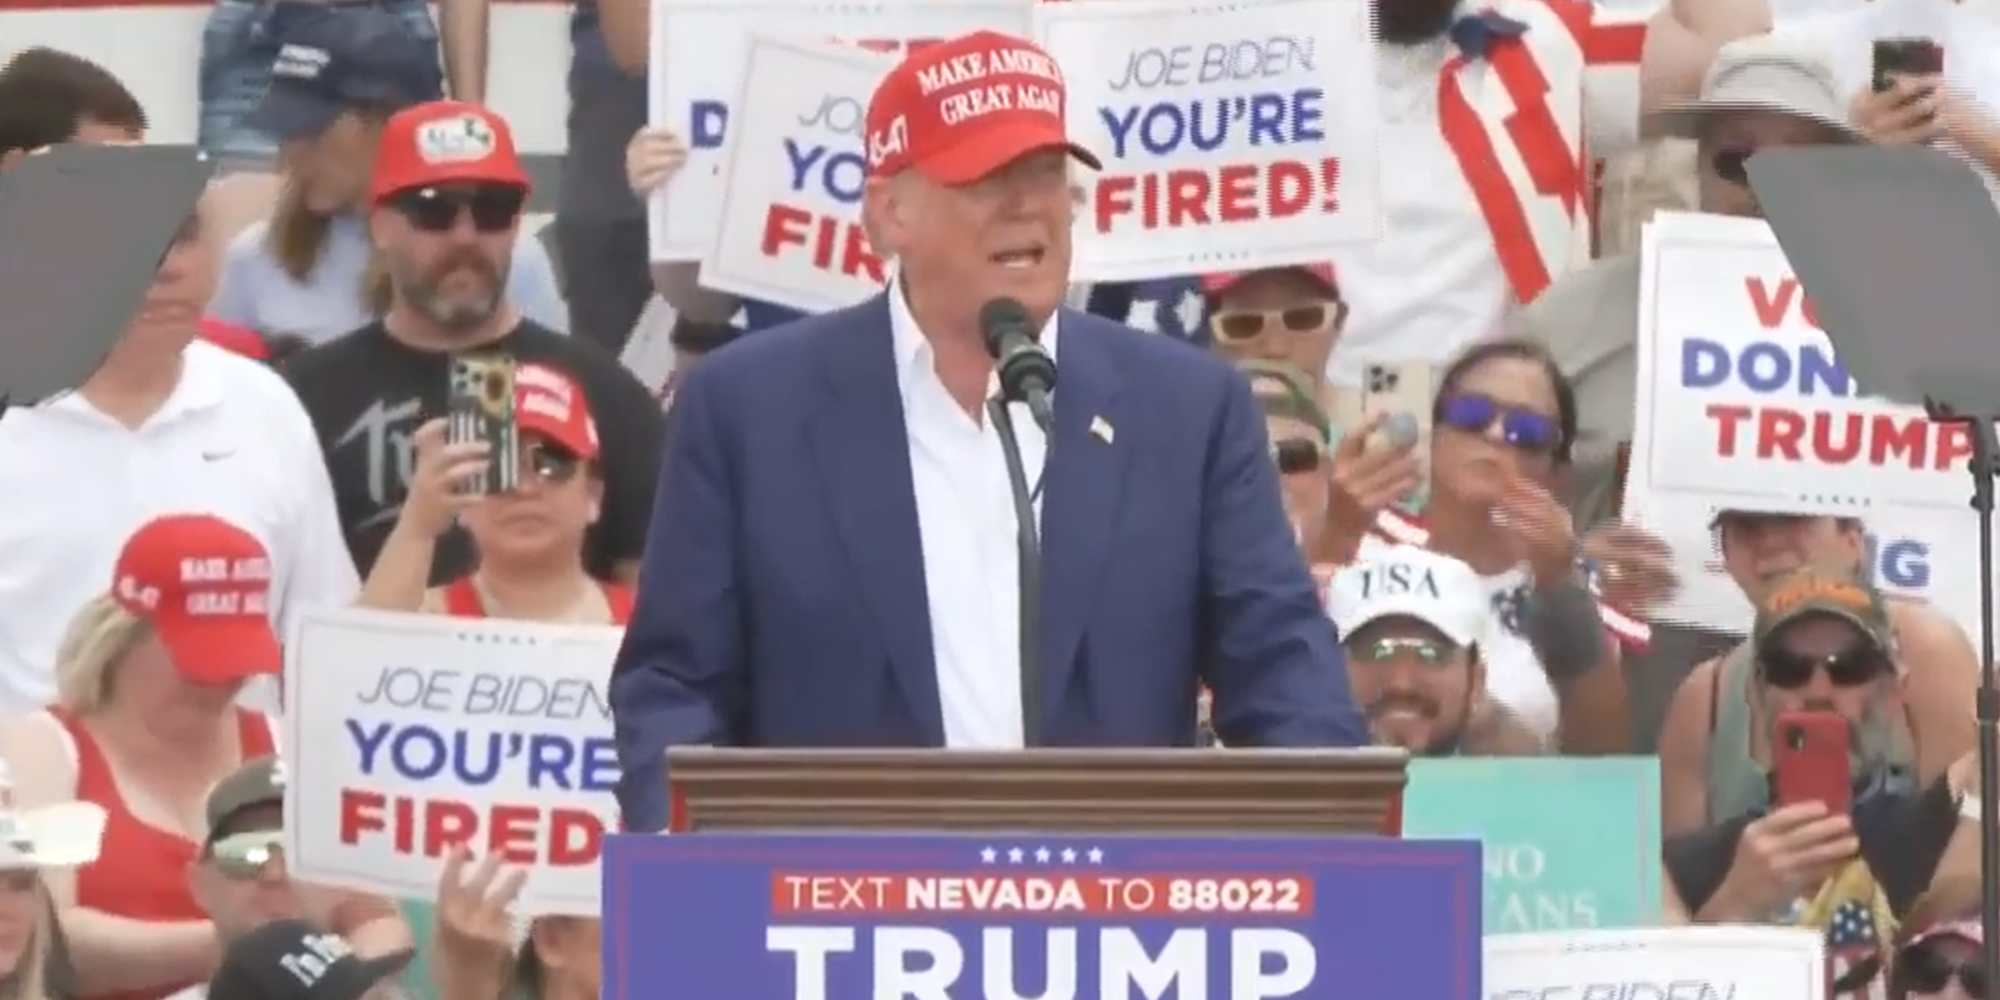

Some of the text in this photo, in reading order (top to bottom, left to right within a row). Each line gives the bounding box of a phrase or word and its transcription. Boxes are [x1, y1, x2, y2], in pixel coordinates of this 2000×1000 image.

[917, 51, 987, 96] MAKE
[1109, 37, 1315, 90] JOE BIDEN
[940, 83, 1013, 125] GREAT
[1100, 89, 1326, 158] YOU'RE
[1095, 157, 1340, 233] FIRED!
[1705, 403, 1976, 472] TRUMP
[1361, 563, 1440, 600] USA
[356, 666, 613, 720] JOE BIDEN
[345, 717, 623, 792] YOU'RE
[340, 787, 606, 866] FIRED
[786, 876, 1301, 912] TEXT NEVADA TO 88022
[765, 925, 1318, 1000] TRUMP
